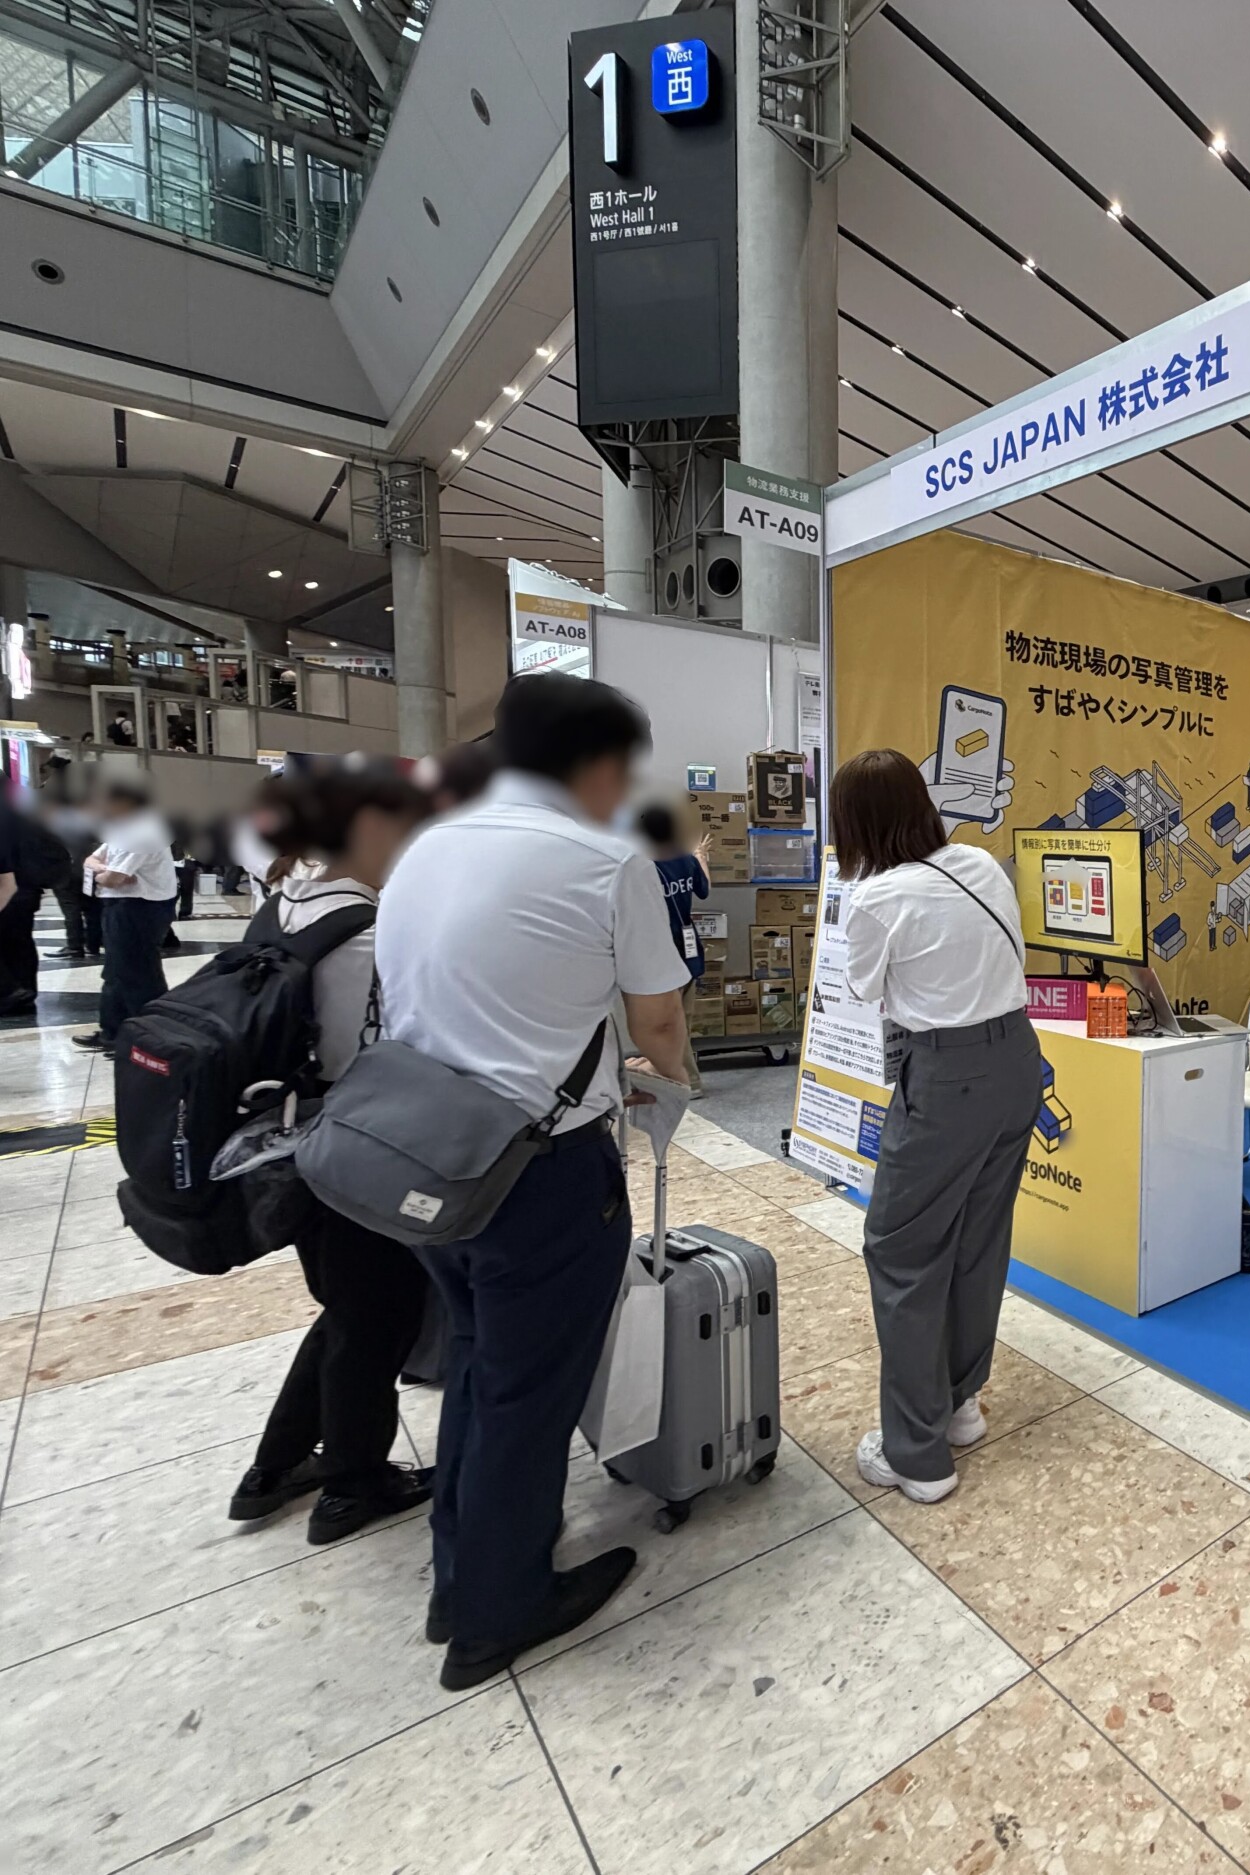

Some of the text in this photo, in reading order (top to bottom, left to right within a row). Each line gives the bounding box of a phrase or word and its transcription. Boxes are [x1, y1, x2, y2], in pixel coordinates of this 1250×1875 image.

[666, 49, 693, 64] West
[667, 66, 693, 106] 西
[584, 52, 618, 163] 1
[589, 185, 657, 210] 西1ホール
[590, 206, 654, 229] West Hall 1
[924, 333, 1230, 499] SCS JAPAN 株式会社
[746, 475, 810, 503] 物流業務支援
[738, 505, 819, 543] AT-A09
[525, 619, 587, 640] AT-A08
[1005, 629, 1230, 701] 物流現場の写真管理を
[1028, 684, 1214, 737] すばやくシンプルに
